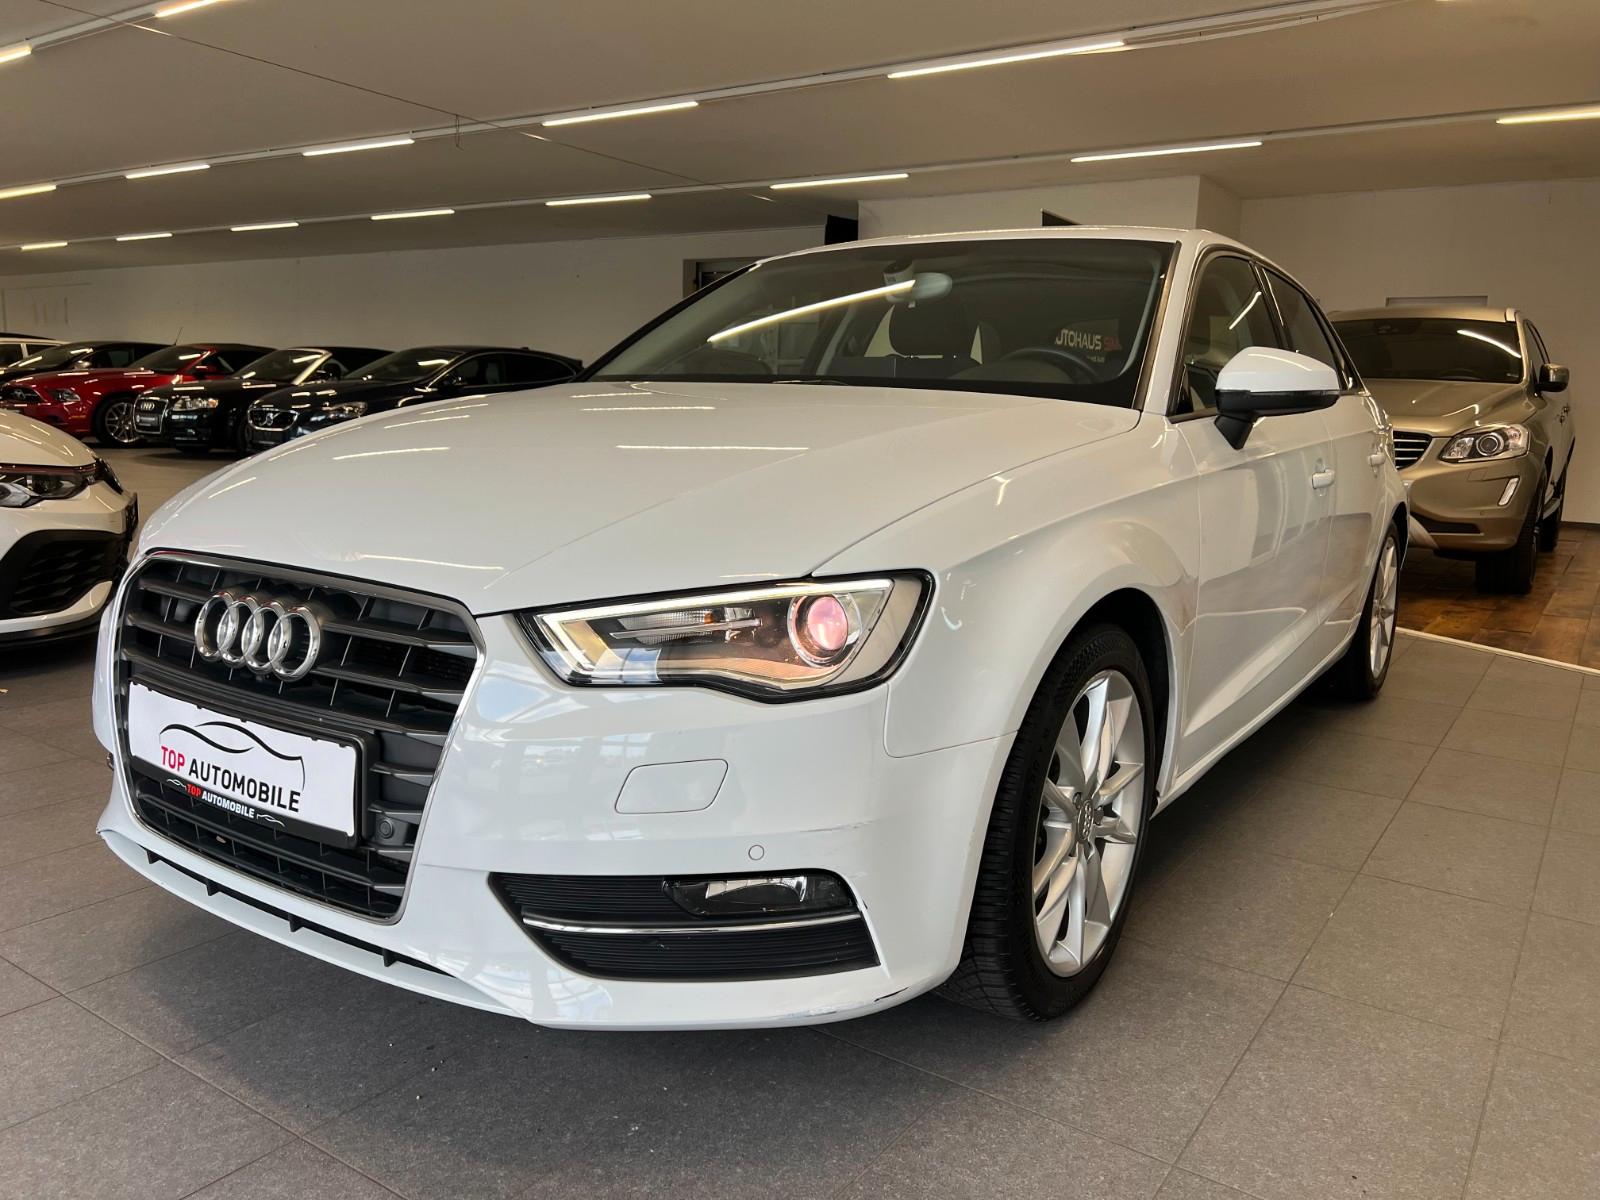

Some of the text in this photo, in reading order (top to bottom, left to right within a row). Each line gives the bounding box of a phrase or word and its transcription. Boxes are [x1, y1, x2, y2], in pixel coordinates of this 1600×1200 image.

[161, 745, 301, 813] TOP AUTOMOBILE
[186, 783, 255, 819] TOP AUTOMOBILE
